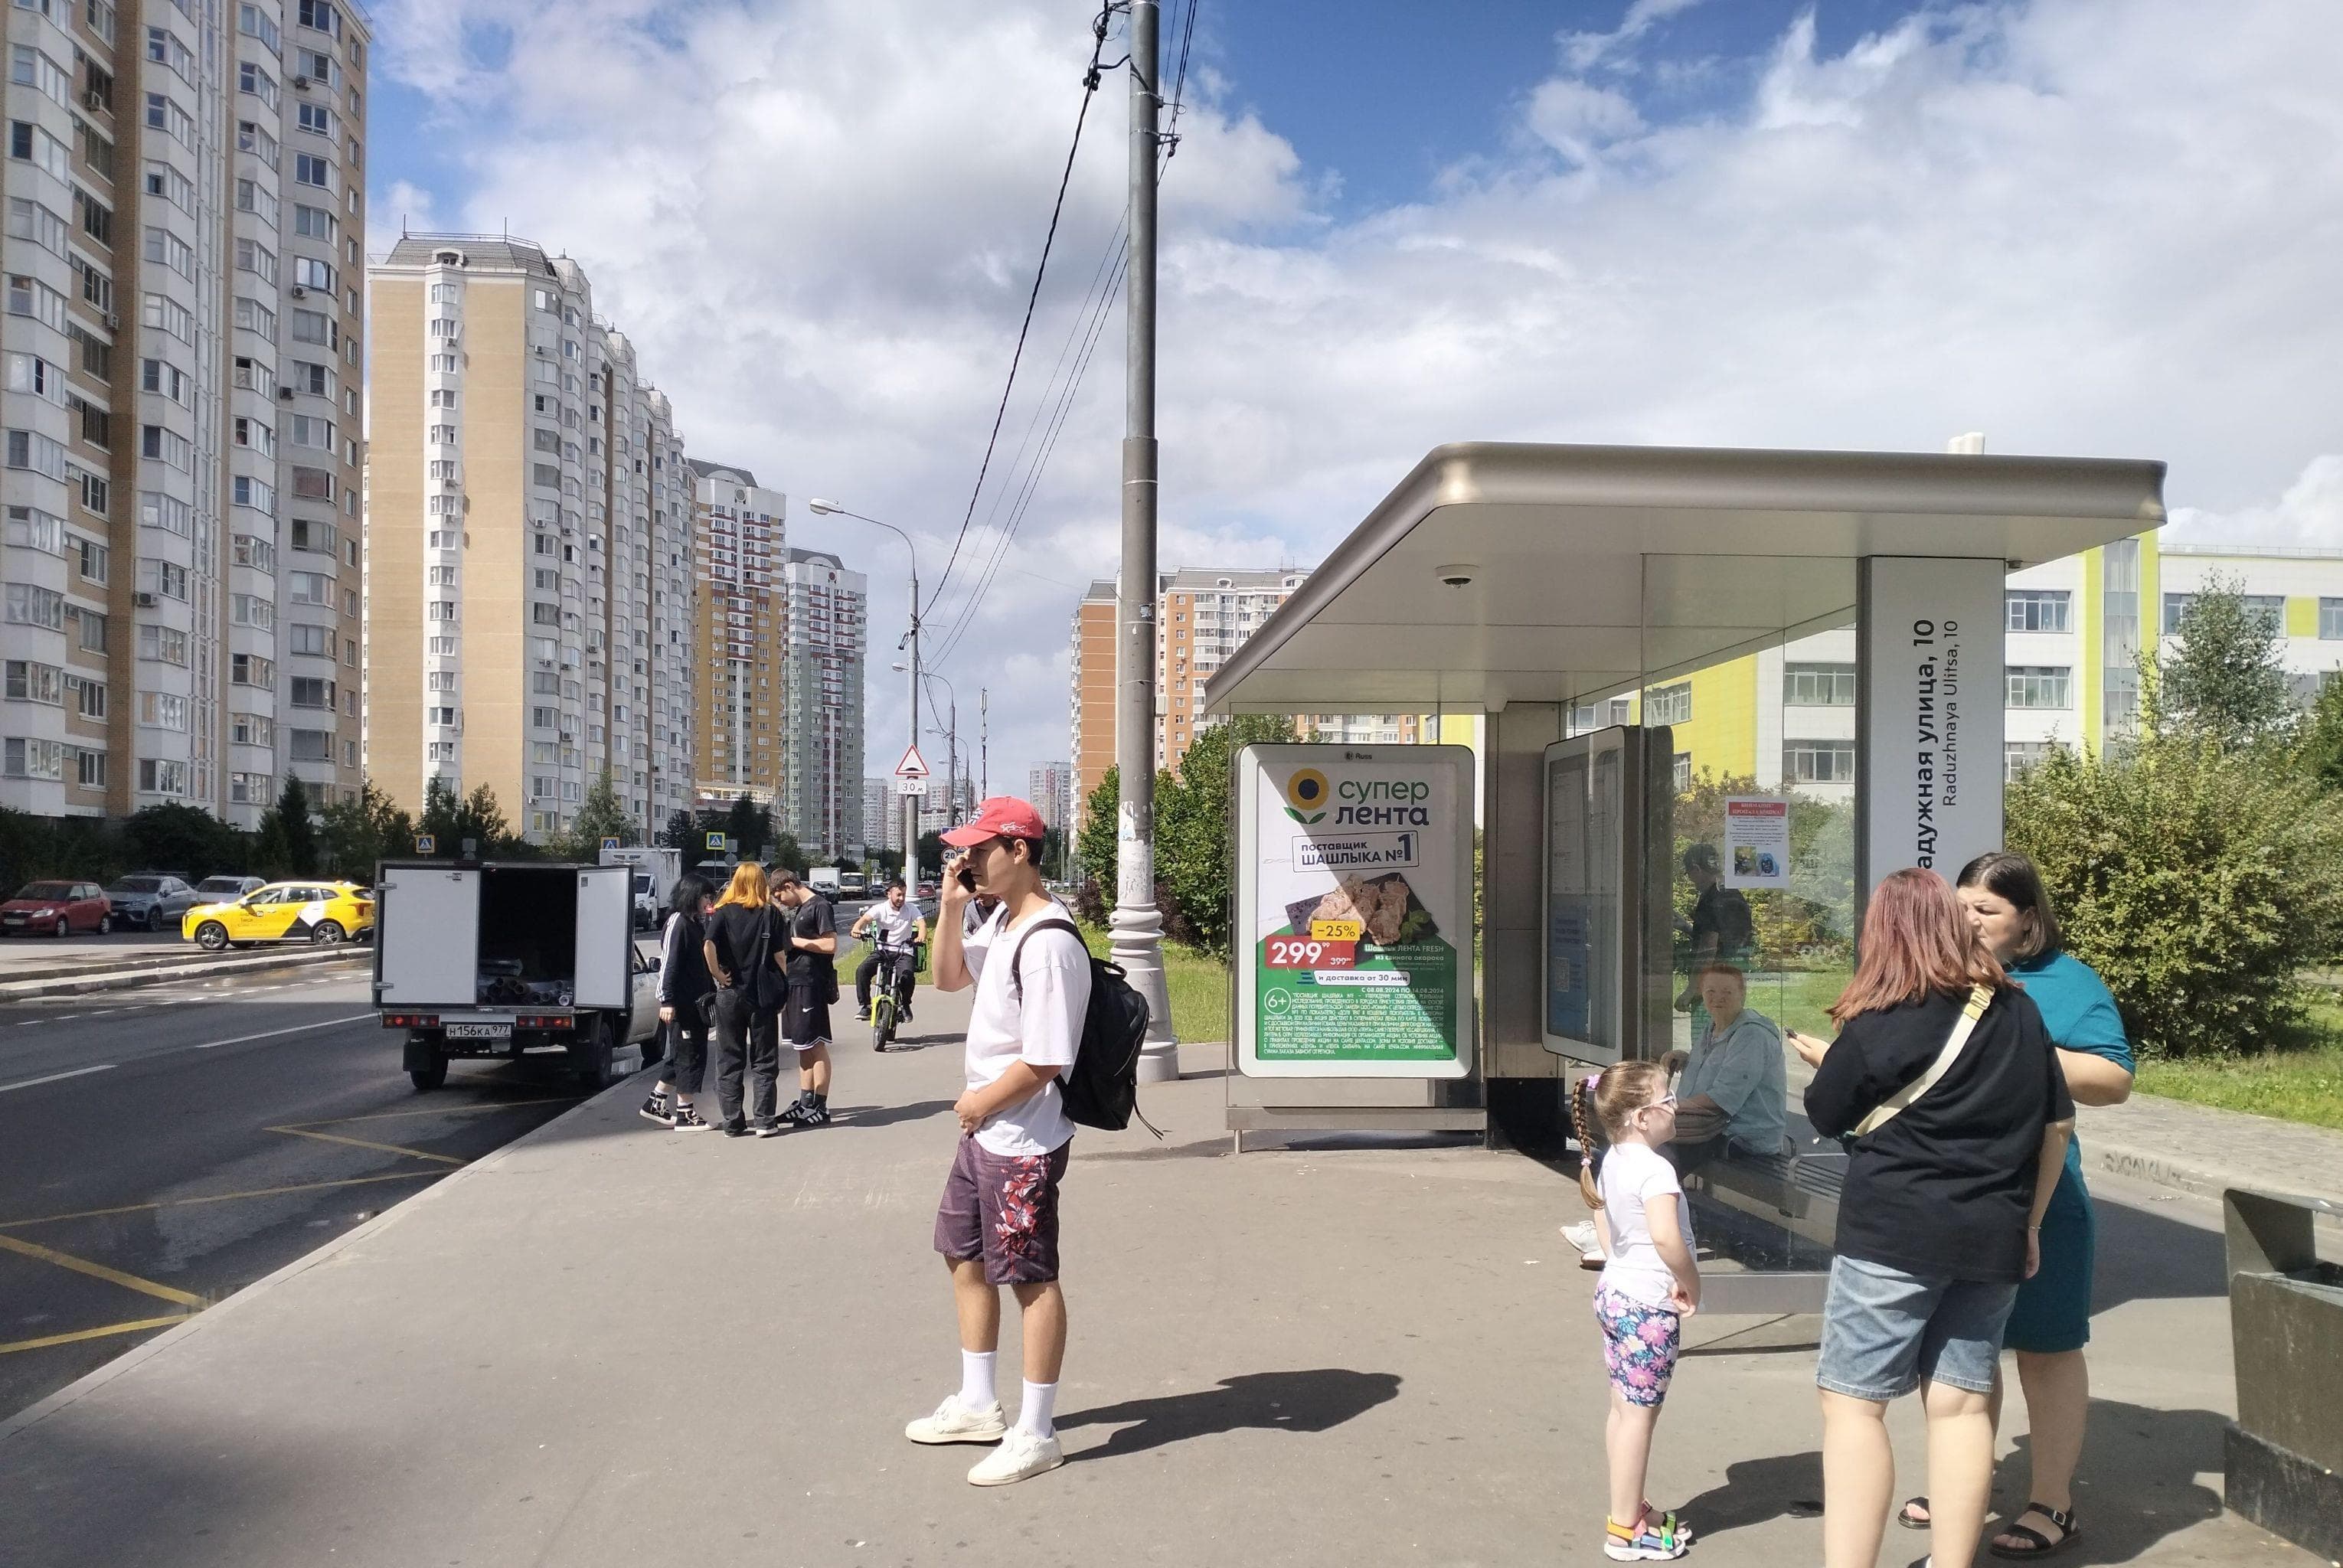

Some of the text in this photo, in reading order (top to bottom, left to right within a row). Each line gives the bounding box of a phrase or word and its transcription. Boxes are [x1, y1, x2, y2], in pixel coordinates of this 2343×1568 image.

[1943, 621, 1960, 806] Raduzhnaya Ulitsa, 10
[1913, 619, 1938, 869] адужная улица, 10
[902, 782, 916, 792] 30
[1338, 781, 1430, 805] супер
[1335, 806, 1430, 826] лента
[1301, 841, 1368, 851] поставщик
[1302, 851, 1382, 865] ШАШЛЫКА
[1268, 995, 1287, 1008] 6+
